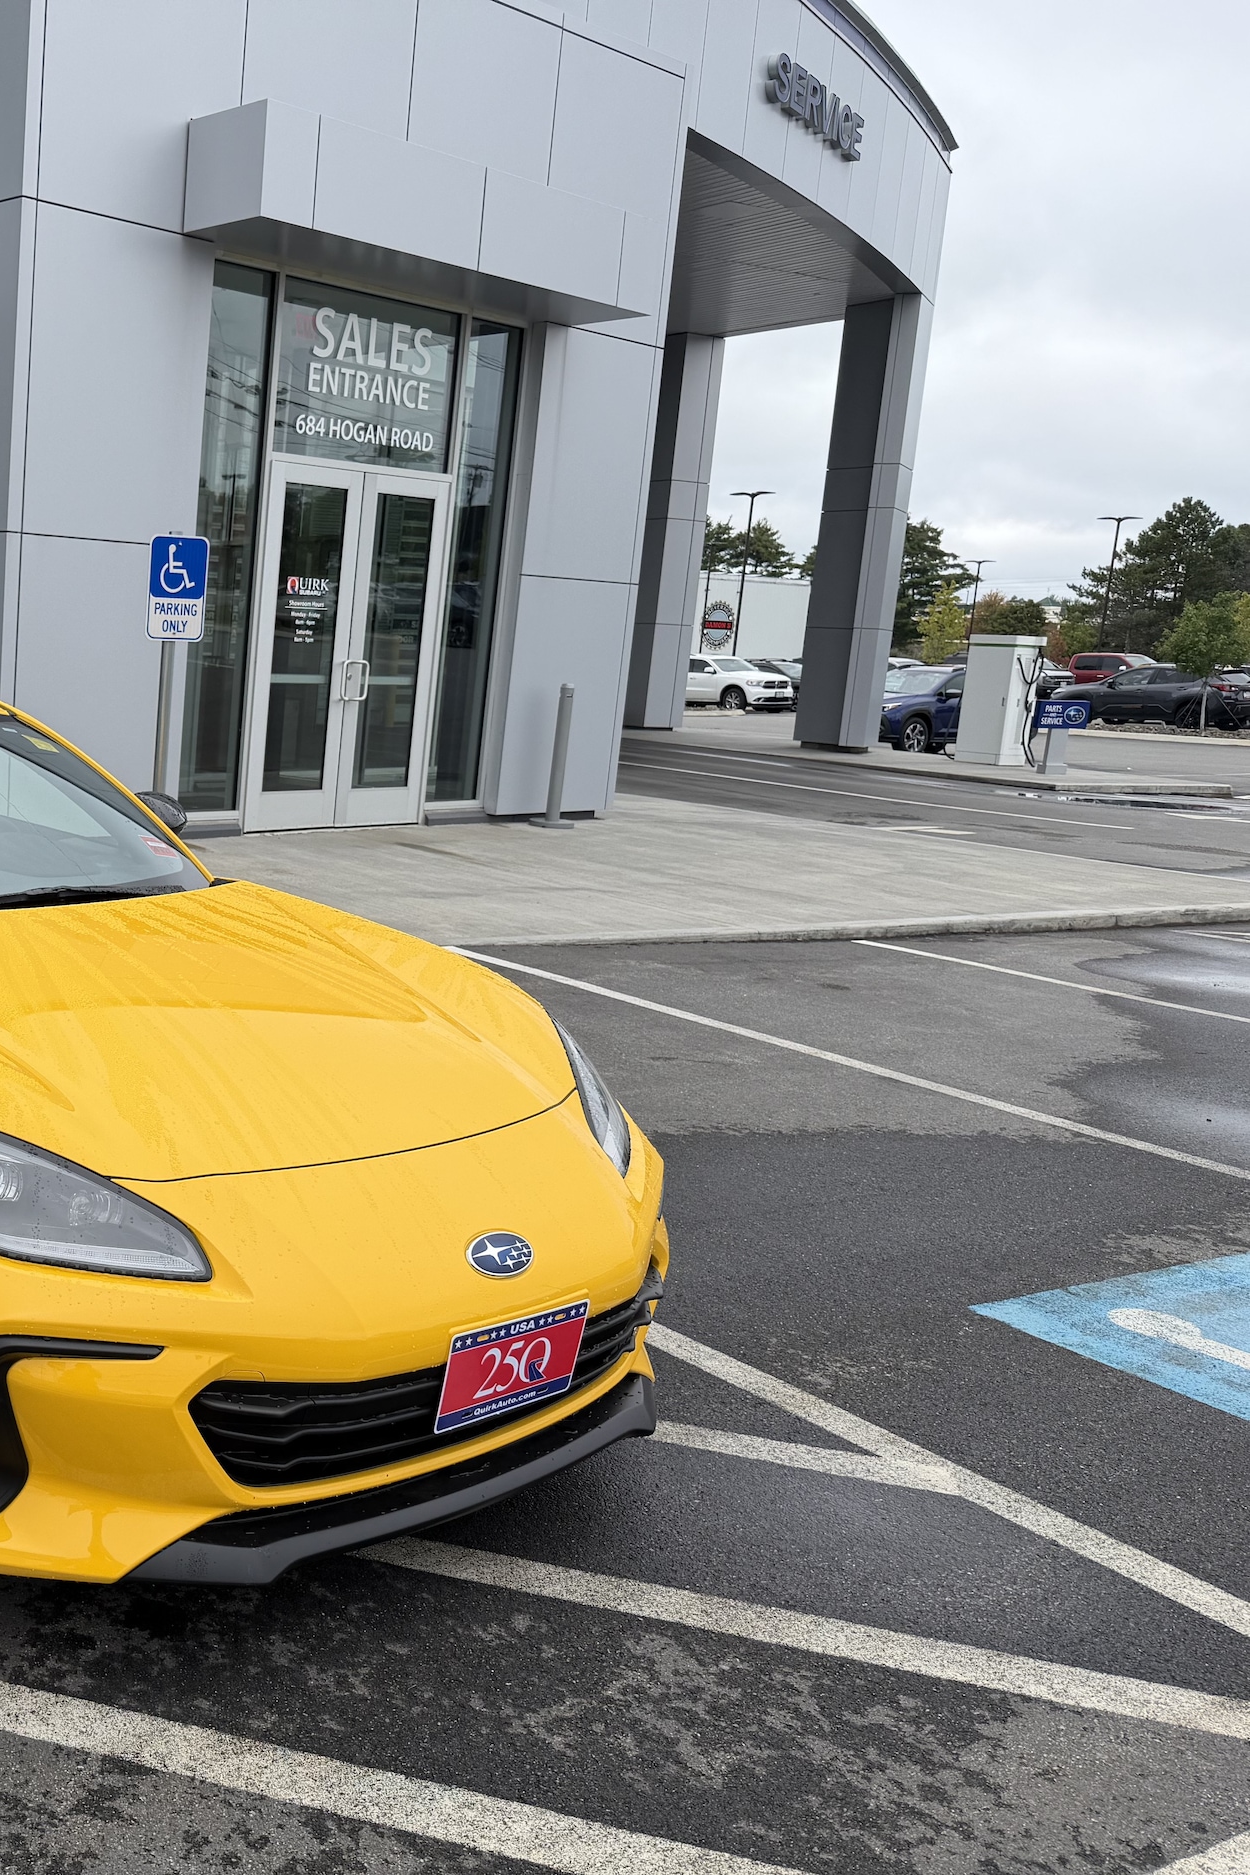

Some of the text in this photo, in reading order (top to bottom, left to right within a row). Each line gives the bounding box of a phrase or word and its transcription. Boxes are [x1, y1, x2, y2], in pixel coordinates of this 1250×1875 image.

[766, 52, 864, 161] SERVICE
[312, 307, 432, 376] SALES
[308, 362, 431, 411] ENTRANCE
[296, 414, 434, 452] 684 HOGAN ROAD
[286, 576, 329, 594] QUIRK
[154, 602, 198, 617] PARKING
[162, 619, 188, 633] ONLY
[1045, 705, 1062, 713] PARTS
[1041, 717, 1063, 725] SERVICE
[510, 1319, 536, 1335] USA
[473, 1390, 536, 1416] QuirkAuto.com
